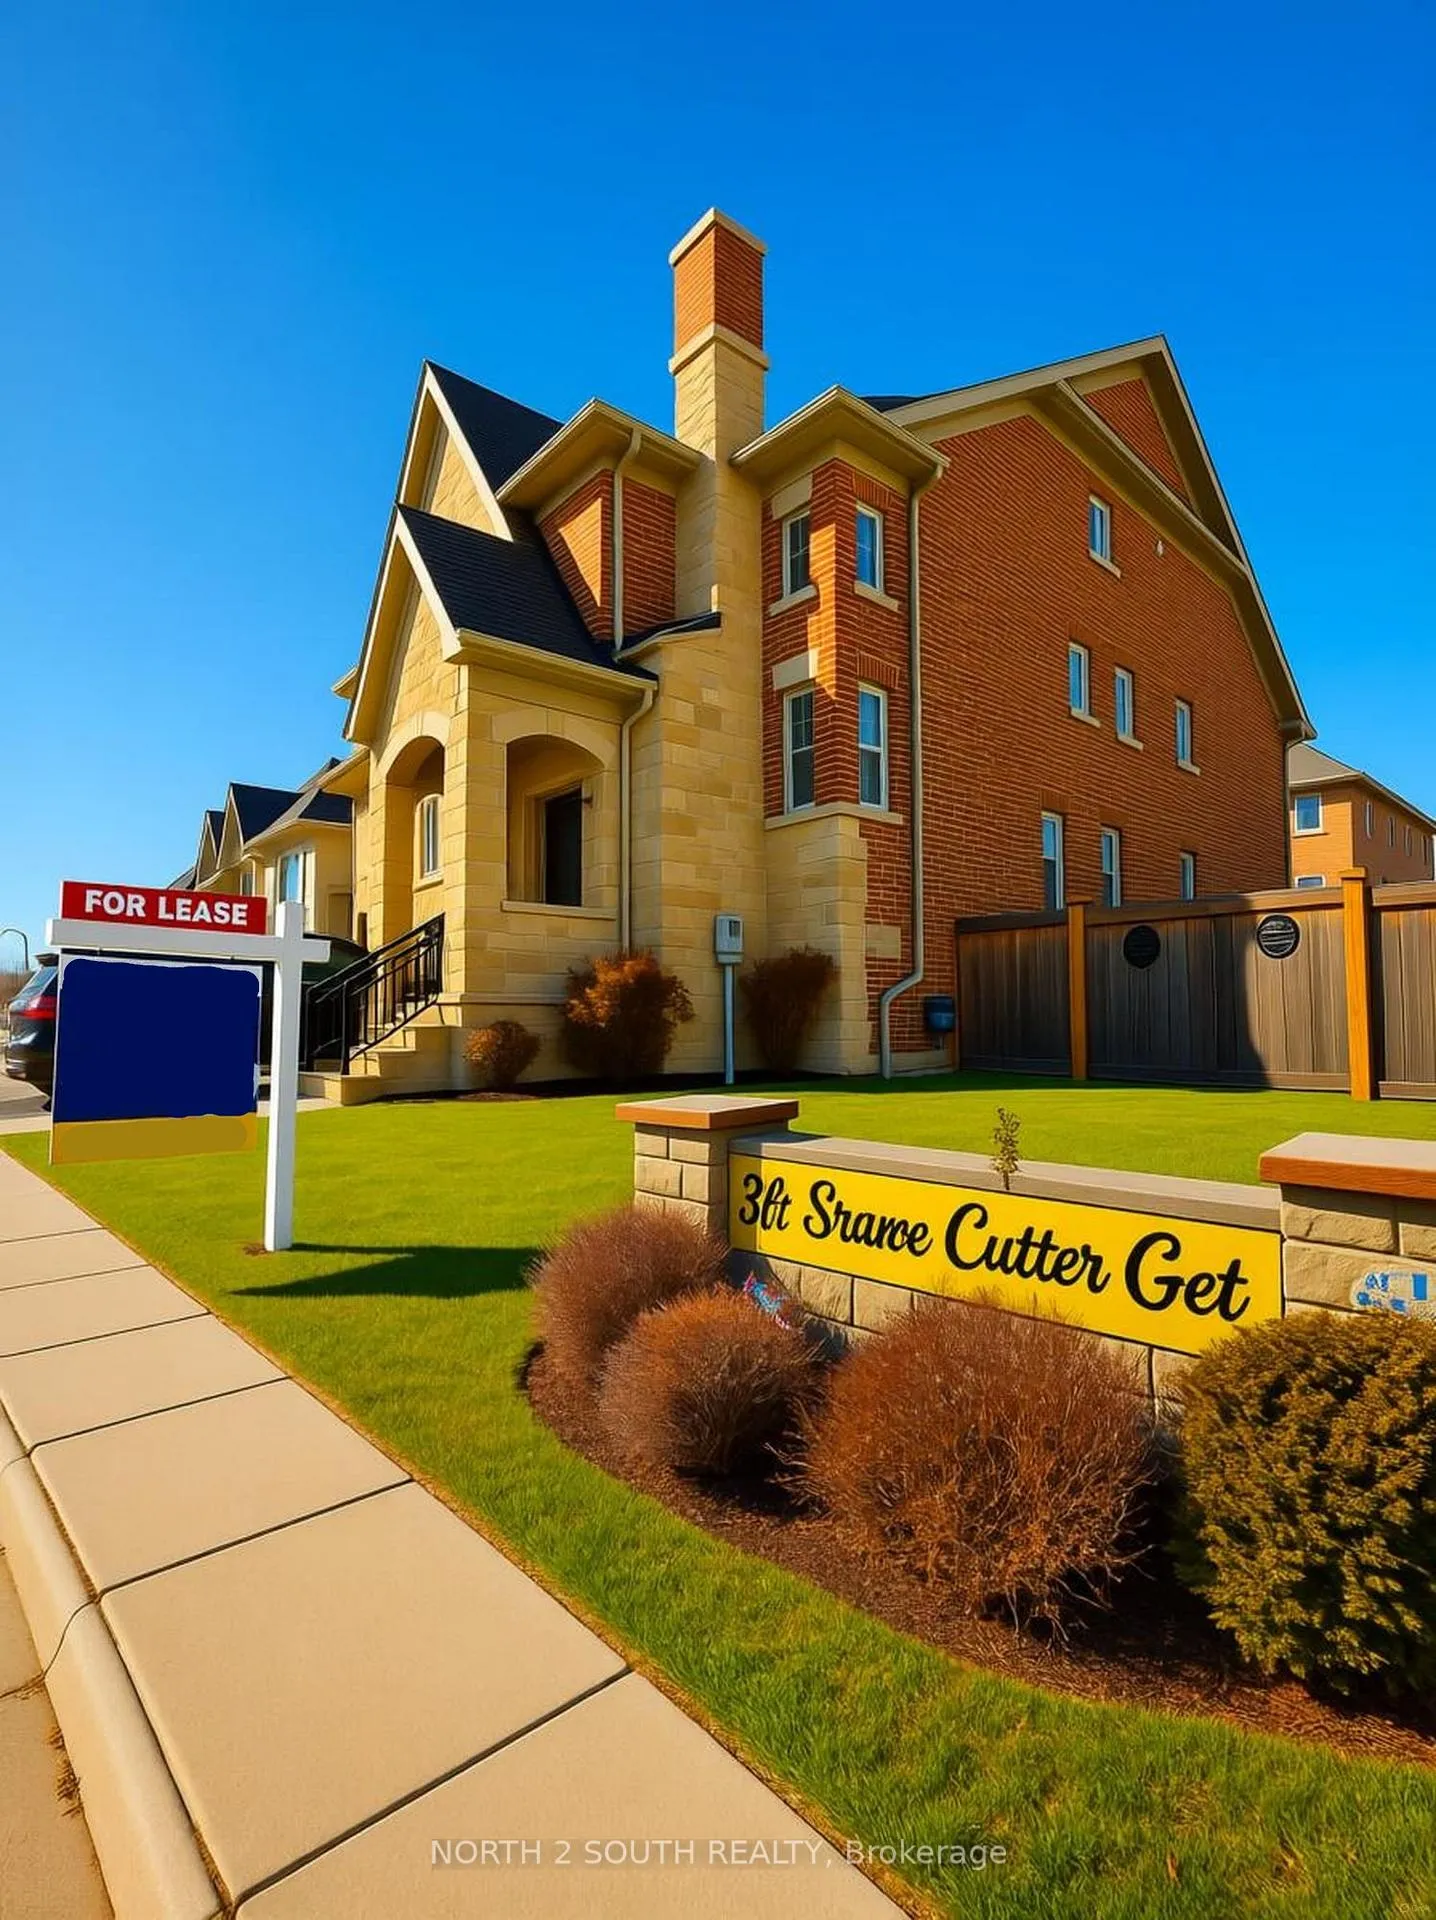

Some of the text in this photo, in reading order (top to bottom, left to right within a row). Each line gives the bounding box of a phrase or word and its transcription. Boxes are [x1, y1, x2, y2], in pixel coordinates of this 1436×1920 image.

[85, 890, 248, 926] FOR LEASE
[944, 1202, 1111, 1294] Cutter
[1124, 1231, 1251, 1322] Get
